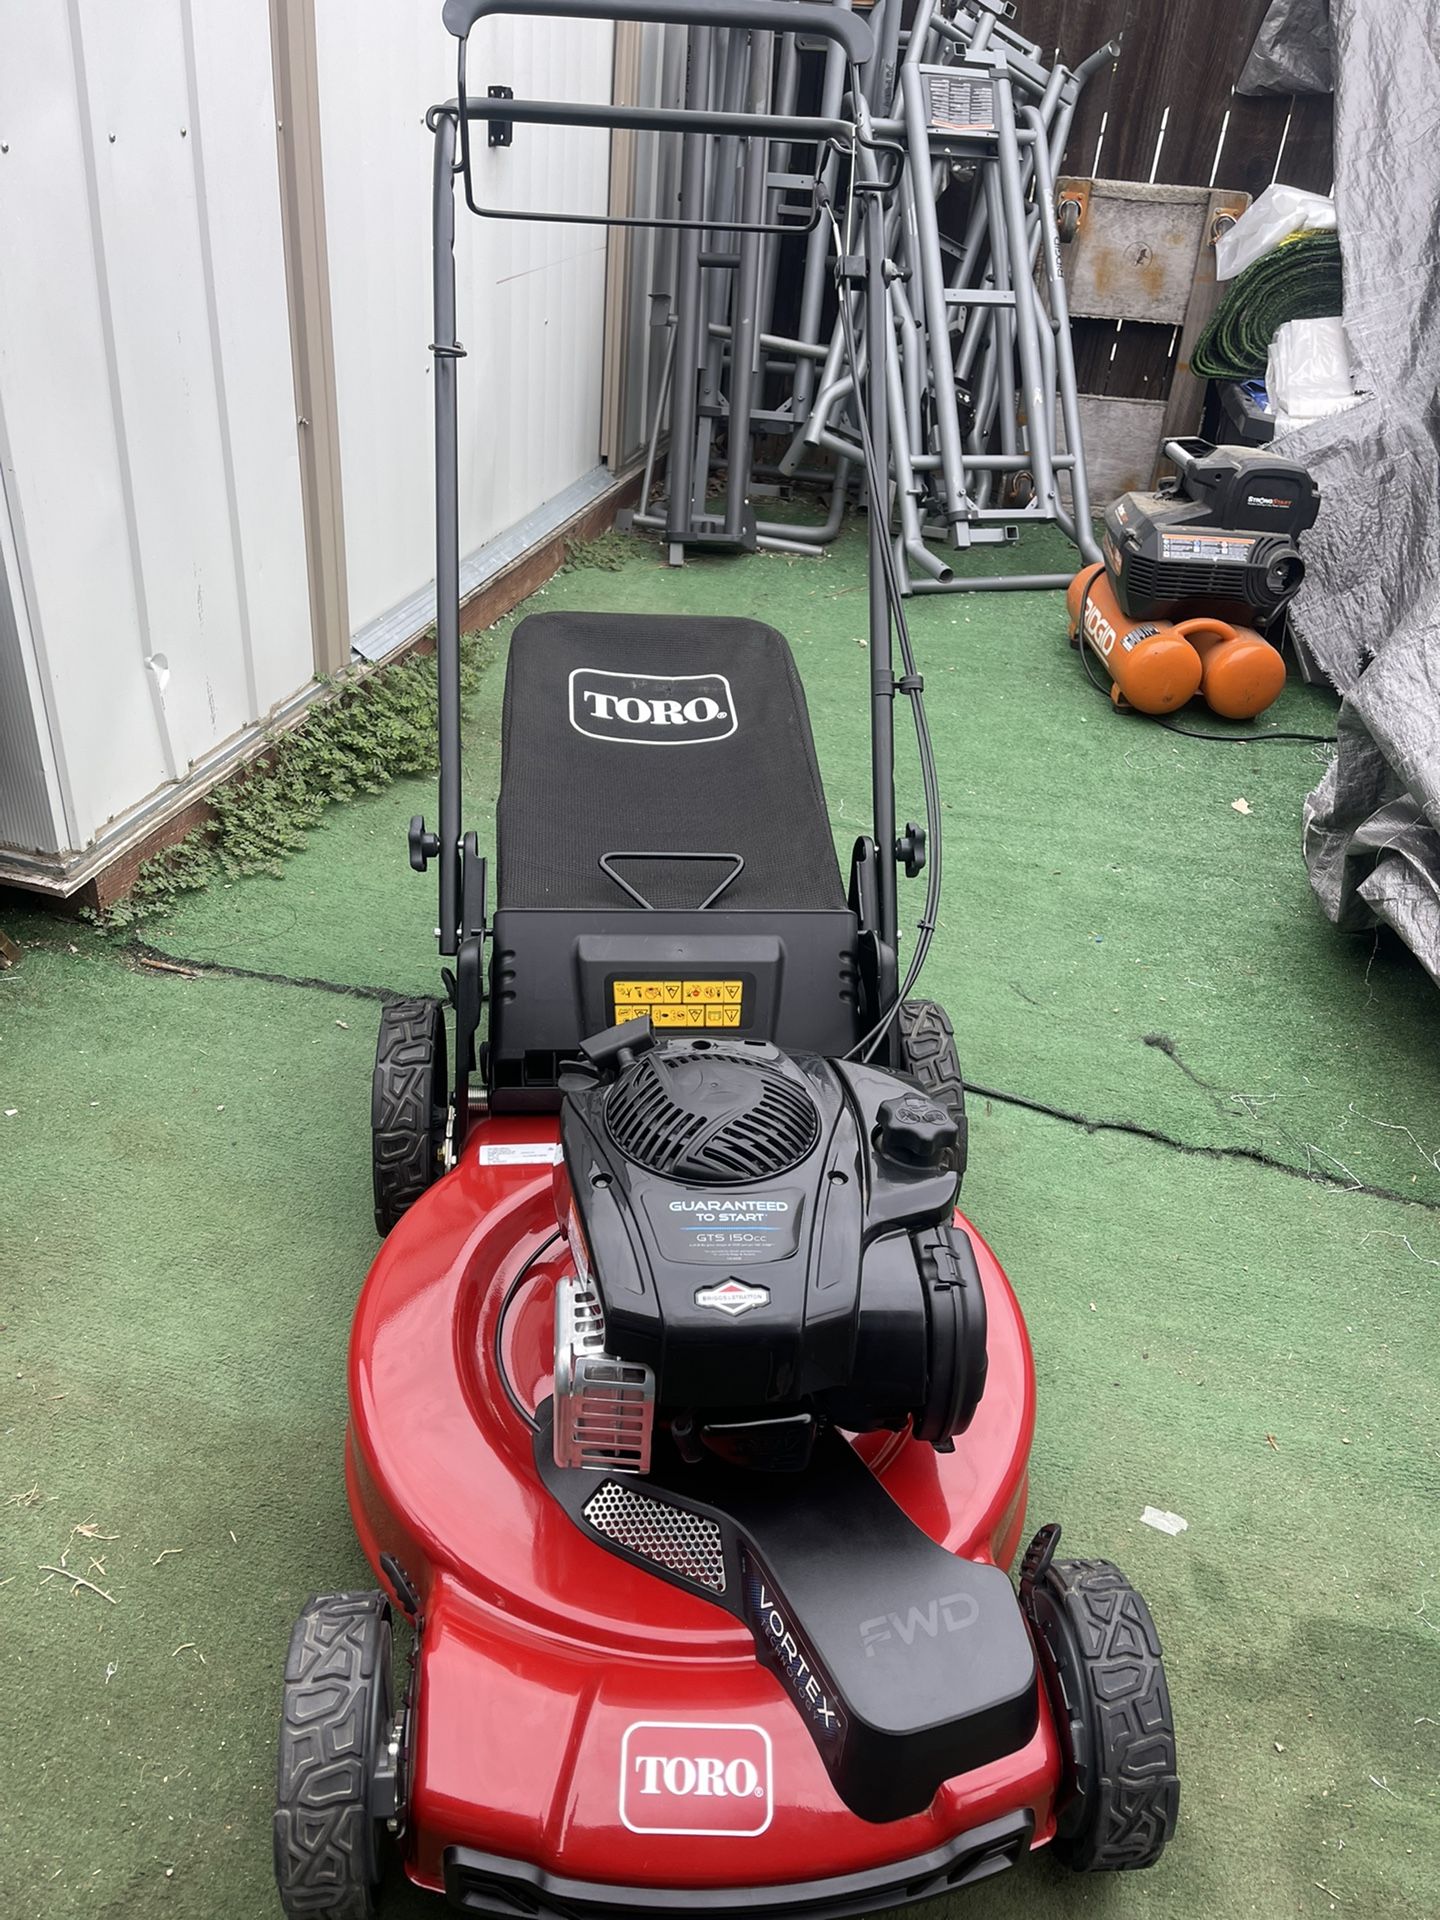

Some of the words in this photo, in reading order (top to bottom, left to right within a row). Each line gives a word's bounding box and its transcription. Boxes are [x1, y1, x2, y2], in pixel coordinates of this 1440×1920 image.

[669, 1201, 788, 1212] GUARANTEED
[696, 1213, 715, 1222] TO
[719, 1213, 764, 1222] START
[696, 1233, 725, 1242] GTS
[729, 1233, 767, 1242] 150cc
[860, 1592, 979, 1658] FWD
[760, 1585, 836, 1729] VORTEX
